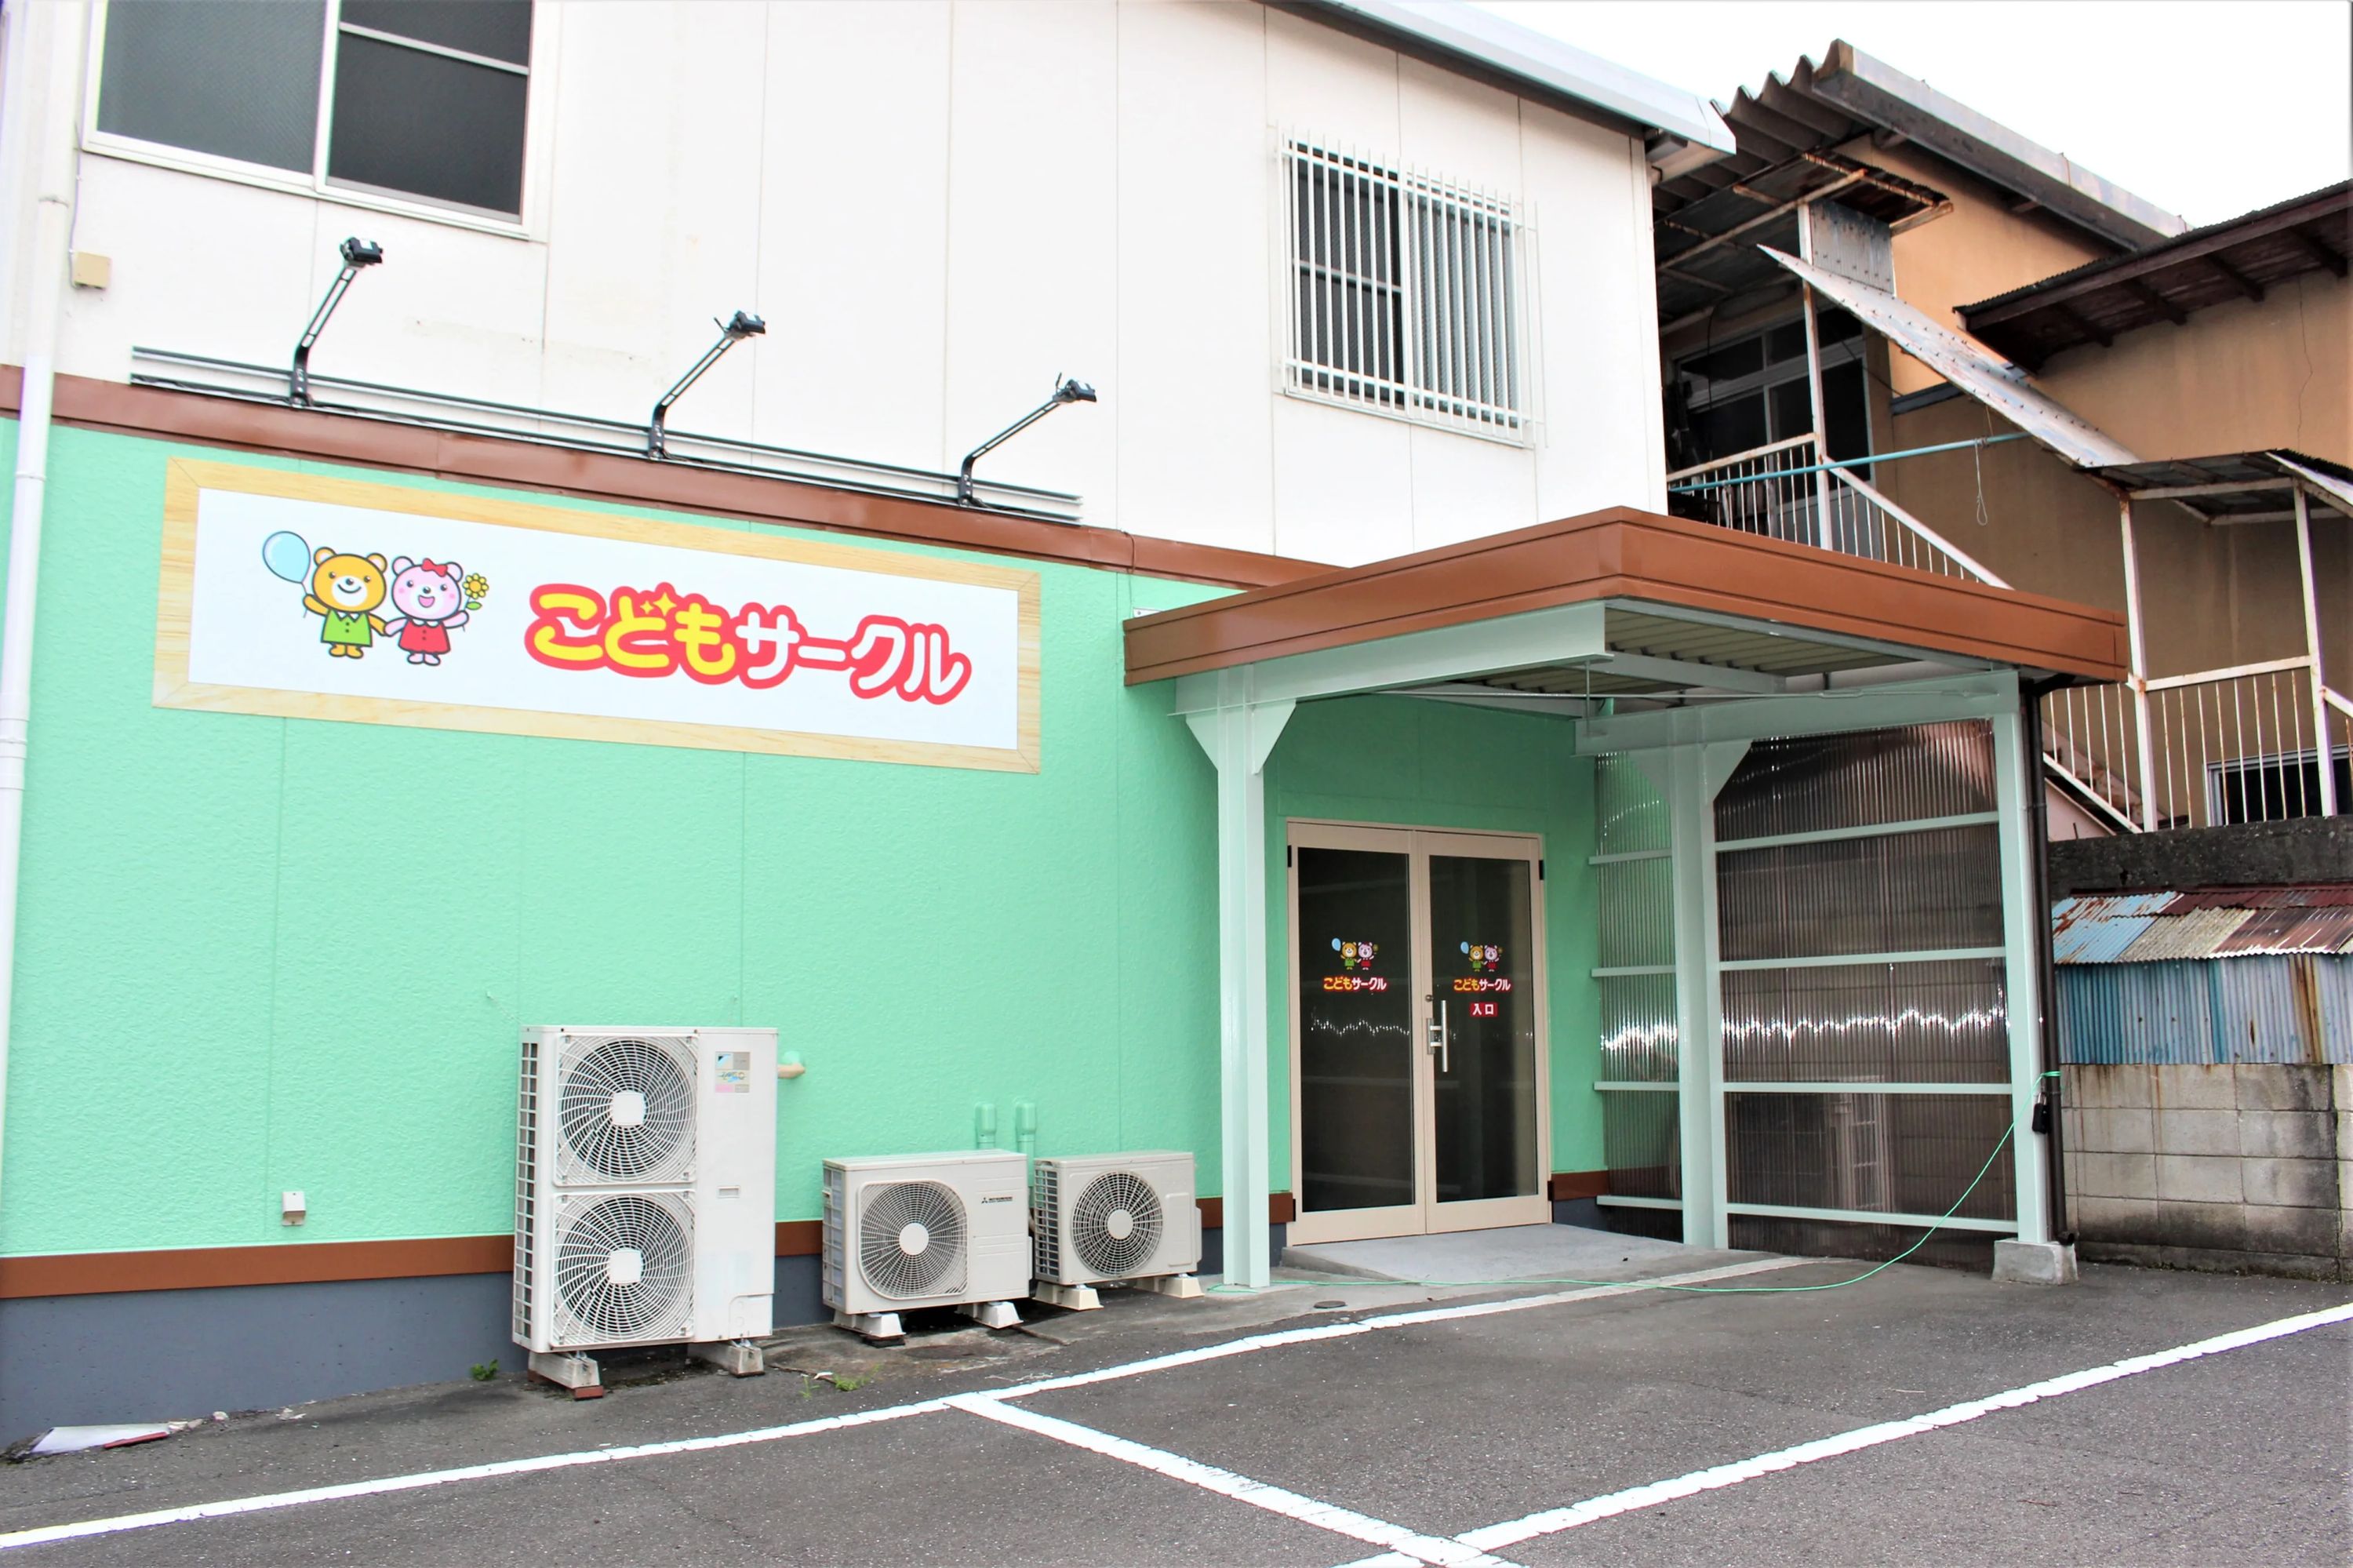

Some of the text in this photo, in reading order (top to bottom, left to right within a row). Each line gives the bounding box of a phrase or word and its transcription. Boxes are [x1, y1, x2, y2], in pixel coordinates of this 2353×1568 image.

[526, 583, 971, 704] こどもサークル
[1323, 976, 1387, 991] こどもサークル
[1453, 977, 1511, 991] こどもサークル
[1472, 1002, 1494, 1016] 入口
